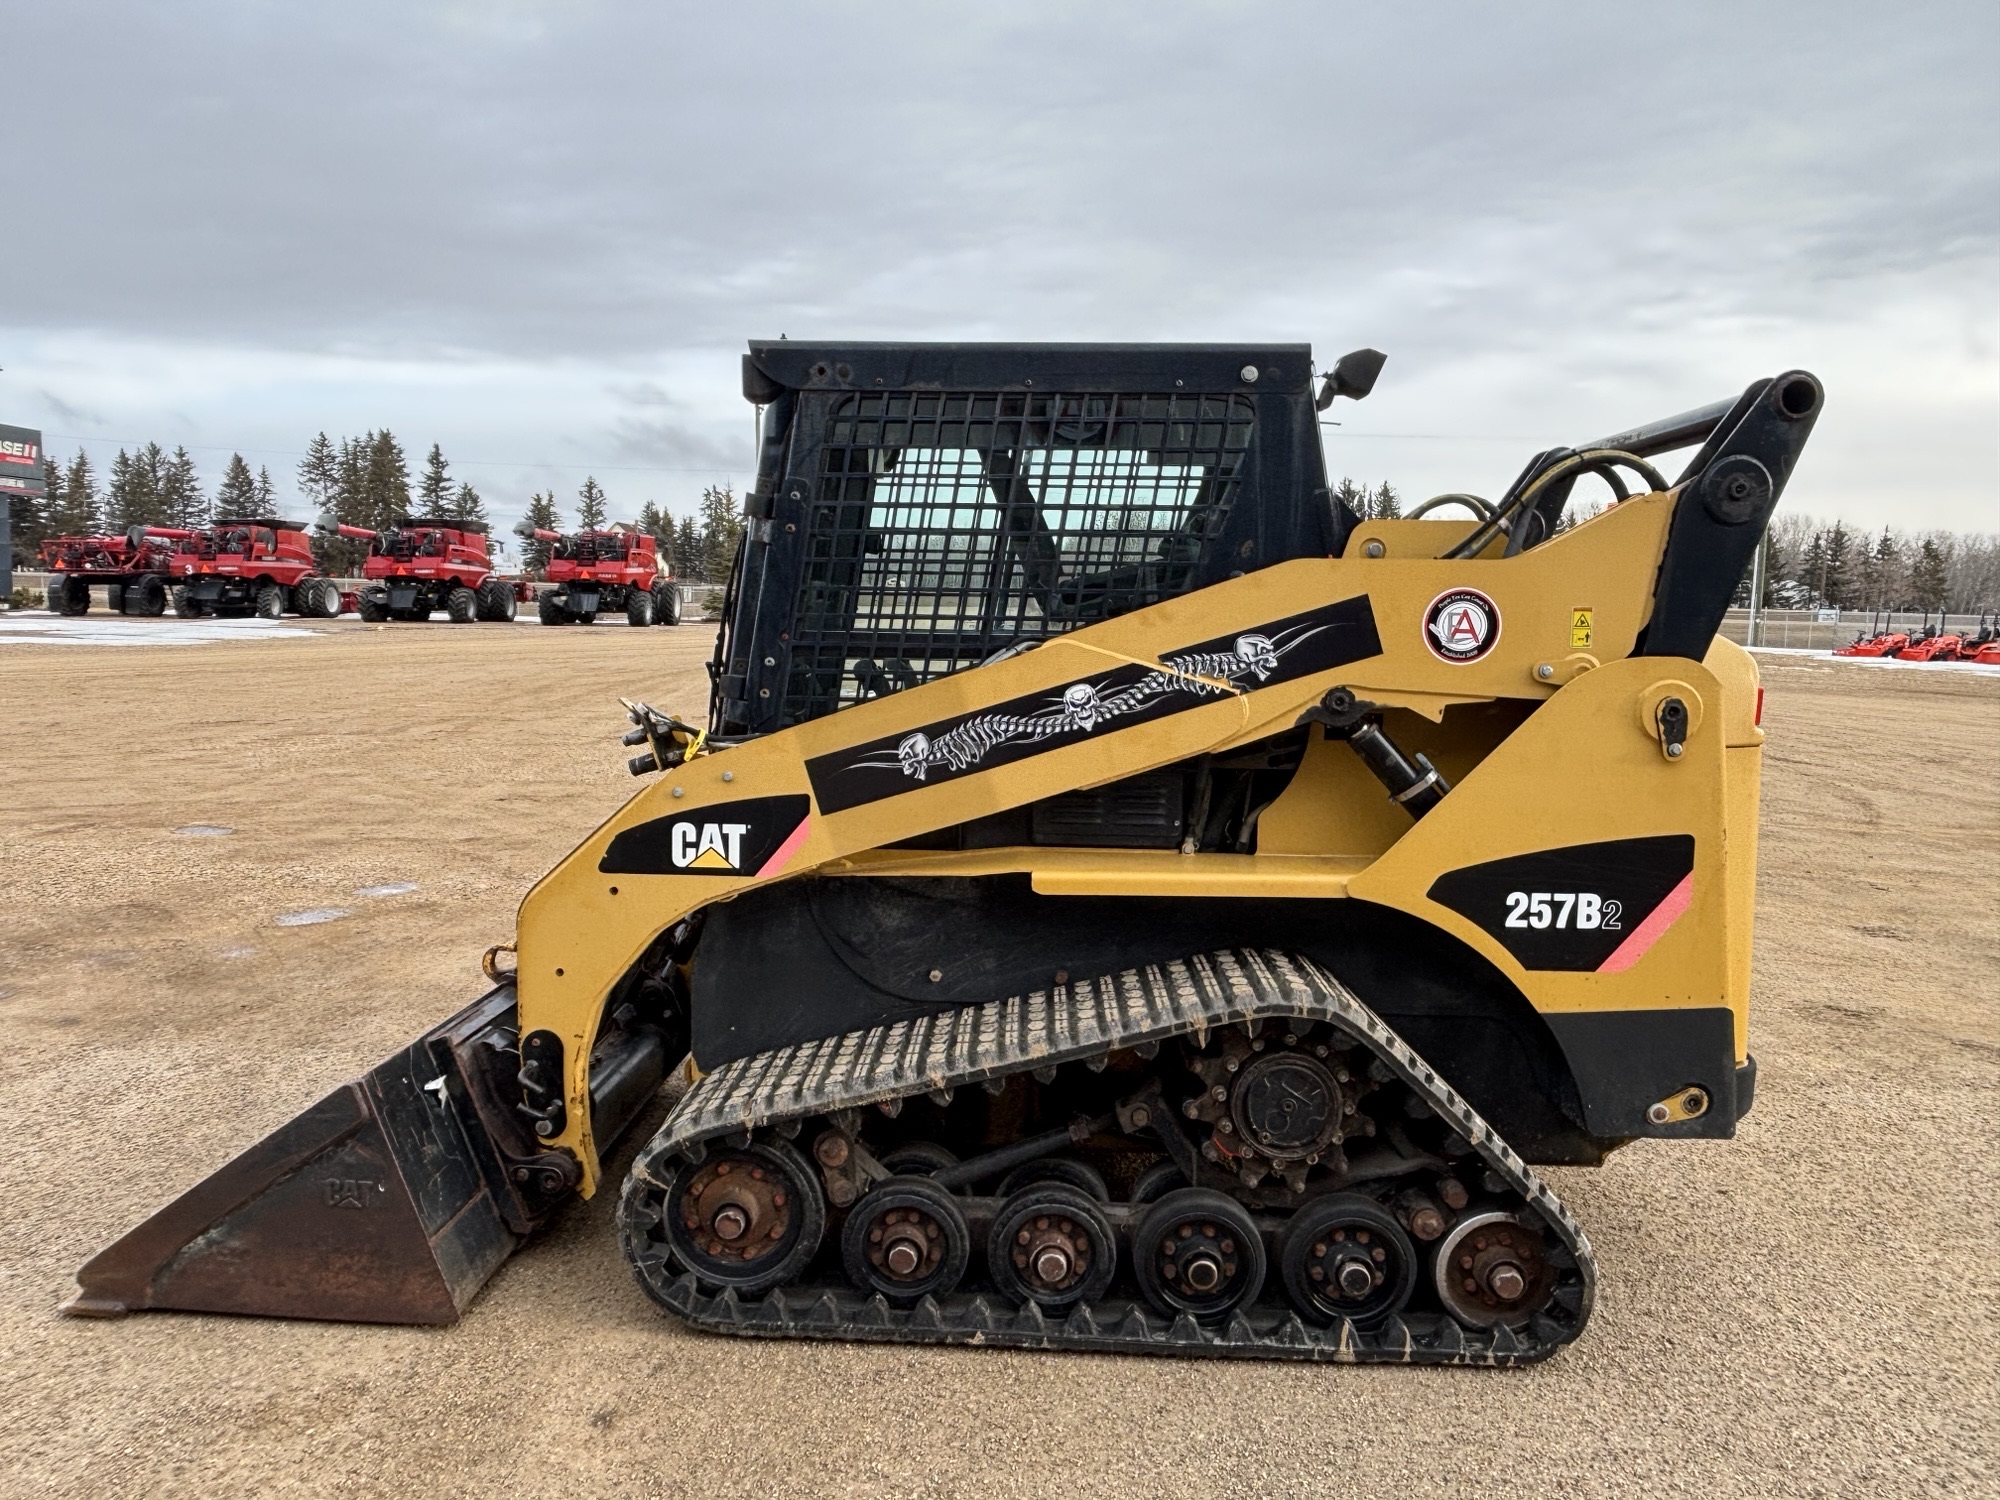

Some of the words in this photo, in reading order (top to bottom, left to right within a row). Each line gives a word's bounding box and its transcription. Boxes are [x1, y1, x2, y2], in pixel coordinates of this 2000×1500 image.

[0, 440, 23, 456] SE
[185, 564, 193, 575] 3
[671, 821, 747, 869] CAT
[1504, 891, 1622, 930] 257B2
[323, 1178, 373, 1208] CAT
